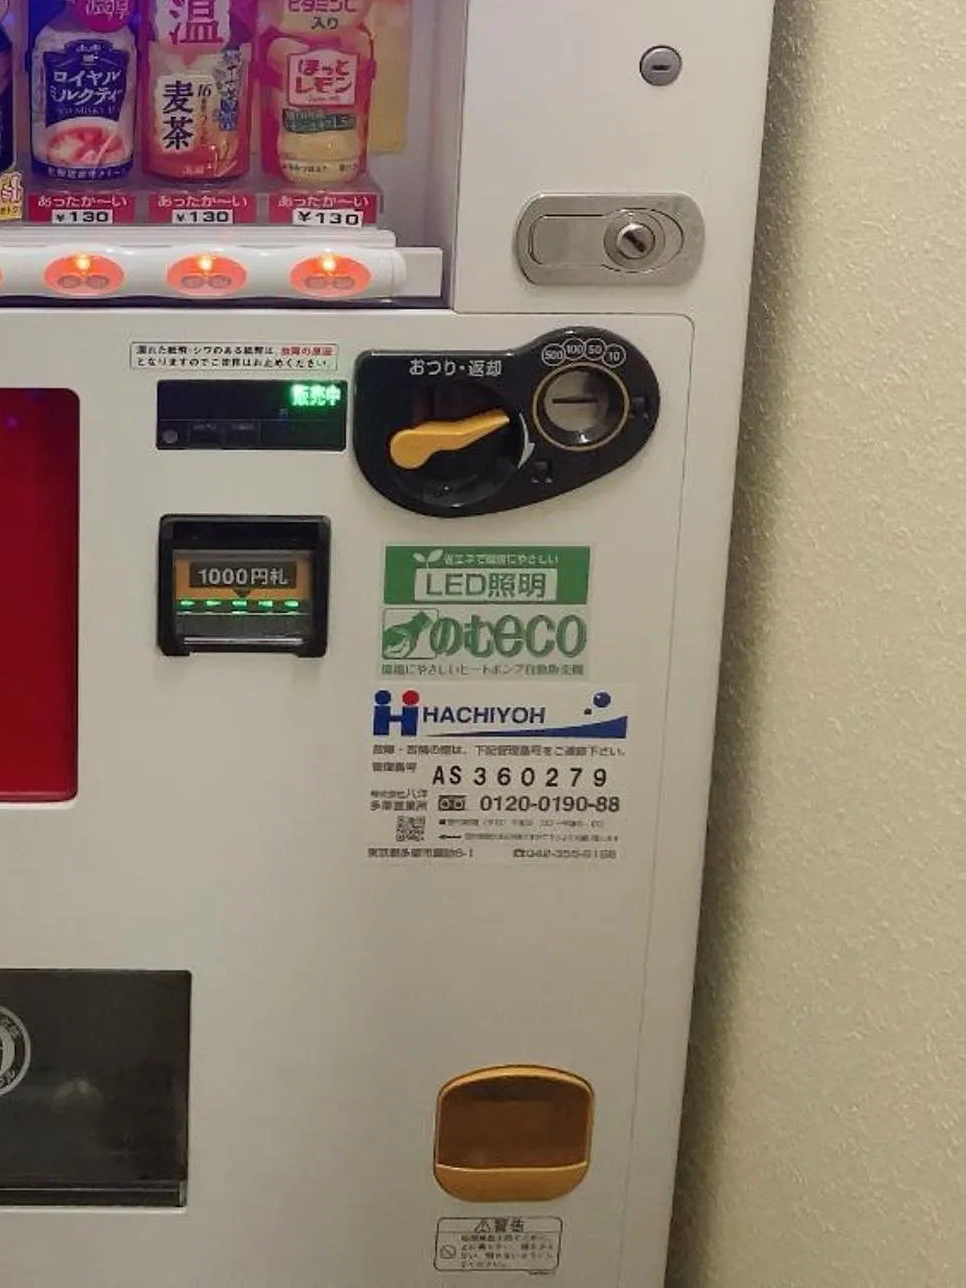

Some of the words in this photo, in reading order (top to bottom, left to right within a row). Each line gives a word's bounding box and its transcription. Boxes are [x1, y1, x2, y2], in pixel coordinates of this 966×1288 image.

[310, 17, 338, 30] 入り
[298, 59, 351, 76] ほっと
[54, 69, 121, 88] ロイヤル
[295, 77, 352, 95] レモン
[162, 79, 194, 151] 麦茶
[544, 349, 563, 360] 500
[609, 351, 620, 361] 10
[409, 359, 502, 377] おつり・返却
[197, 568, 288, 585] 1000円札
[425, 573, 547, 599] LED照明
[423, 706, 546, 724] HACHIYOH
[480, 795, 620, 812] 0120-0190-88
